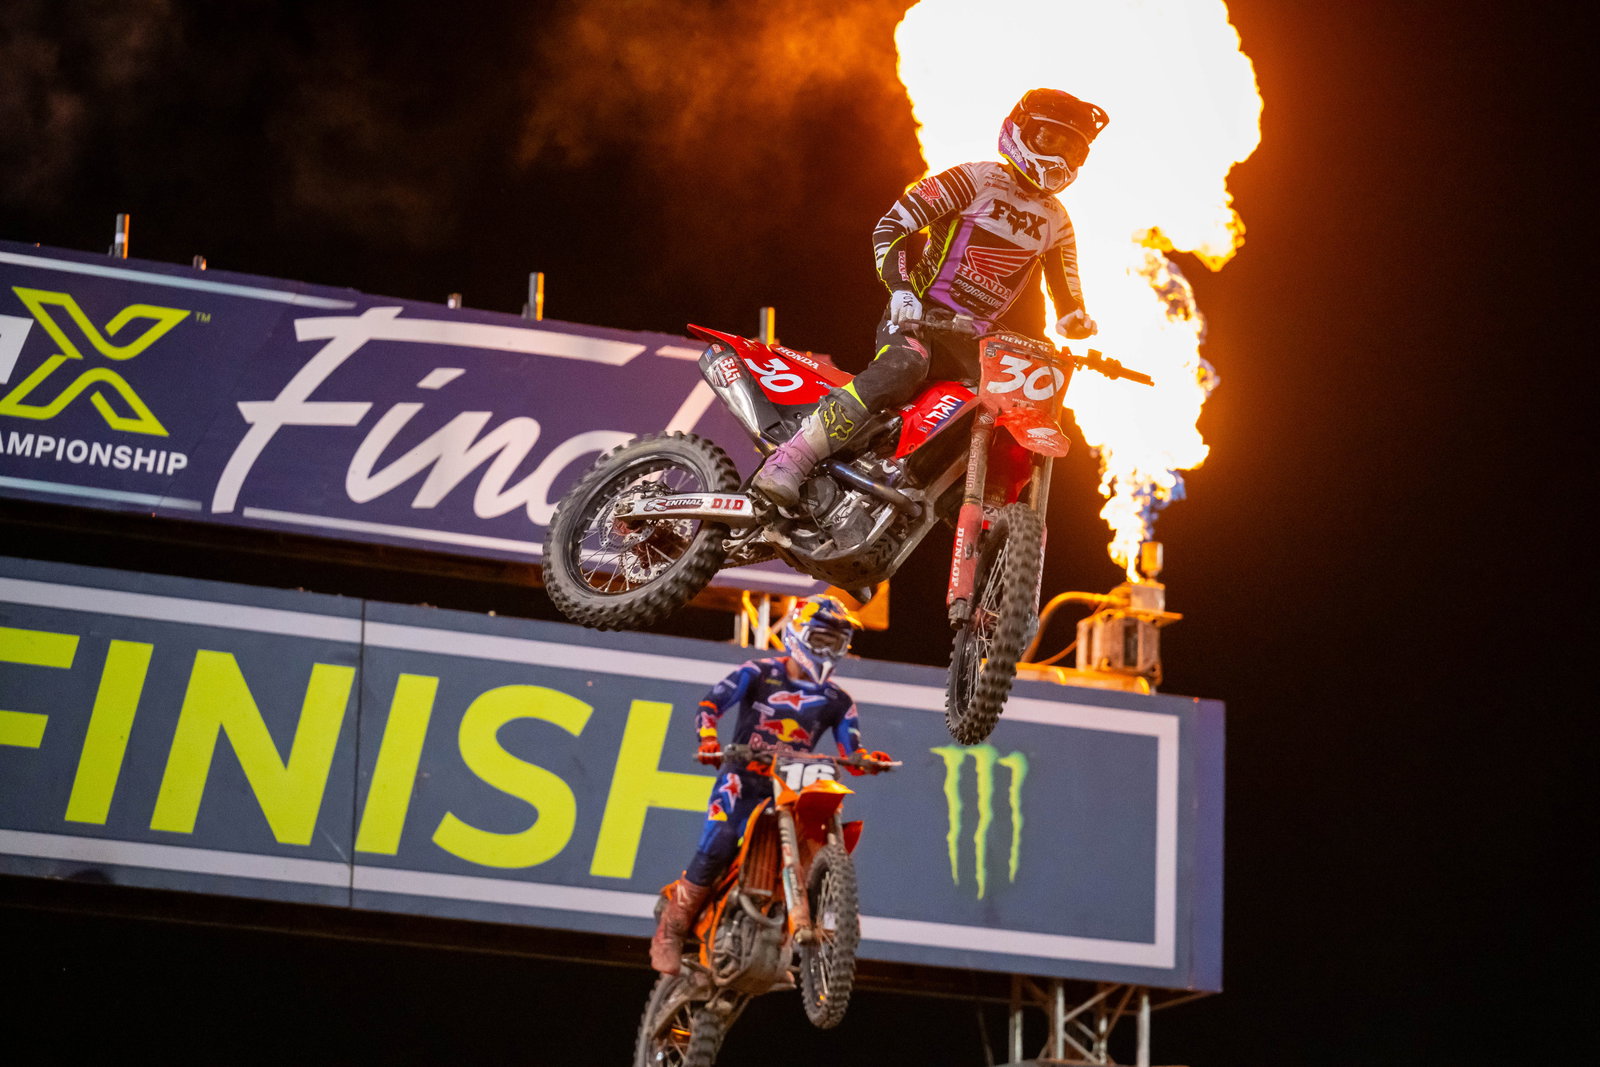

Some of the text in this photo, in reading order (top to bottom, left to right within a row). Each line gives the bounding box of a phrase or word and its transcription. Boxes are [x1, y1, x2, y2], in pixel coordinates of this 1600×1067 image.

[989, 199, 1047, 240] FOX
[955, 263, 1013, 300] HONDA
[955, 278, 1005, 309] PROGRESSIVE
[744, 358, 804, 393] 30
[775, 346, 820, 372] HONDA
[986, 354, 1066, 402] 30
[0, 430, 188, 476] MPIONSHIP
[951, 527, 965, 588] DUNLOP
[780, 762, 836, 791] 16
